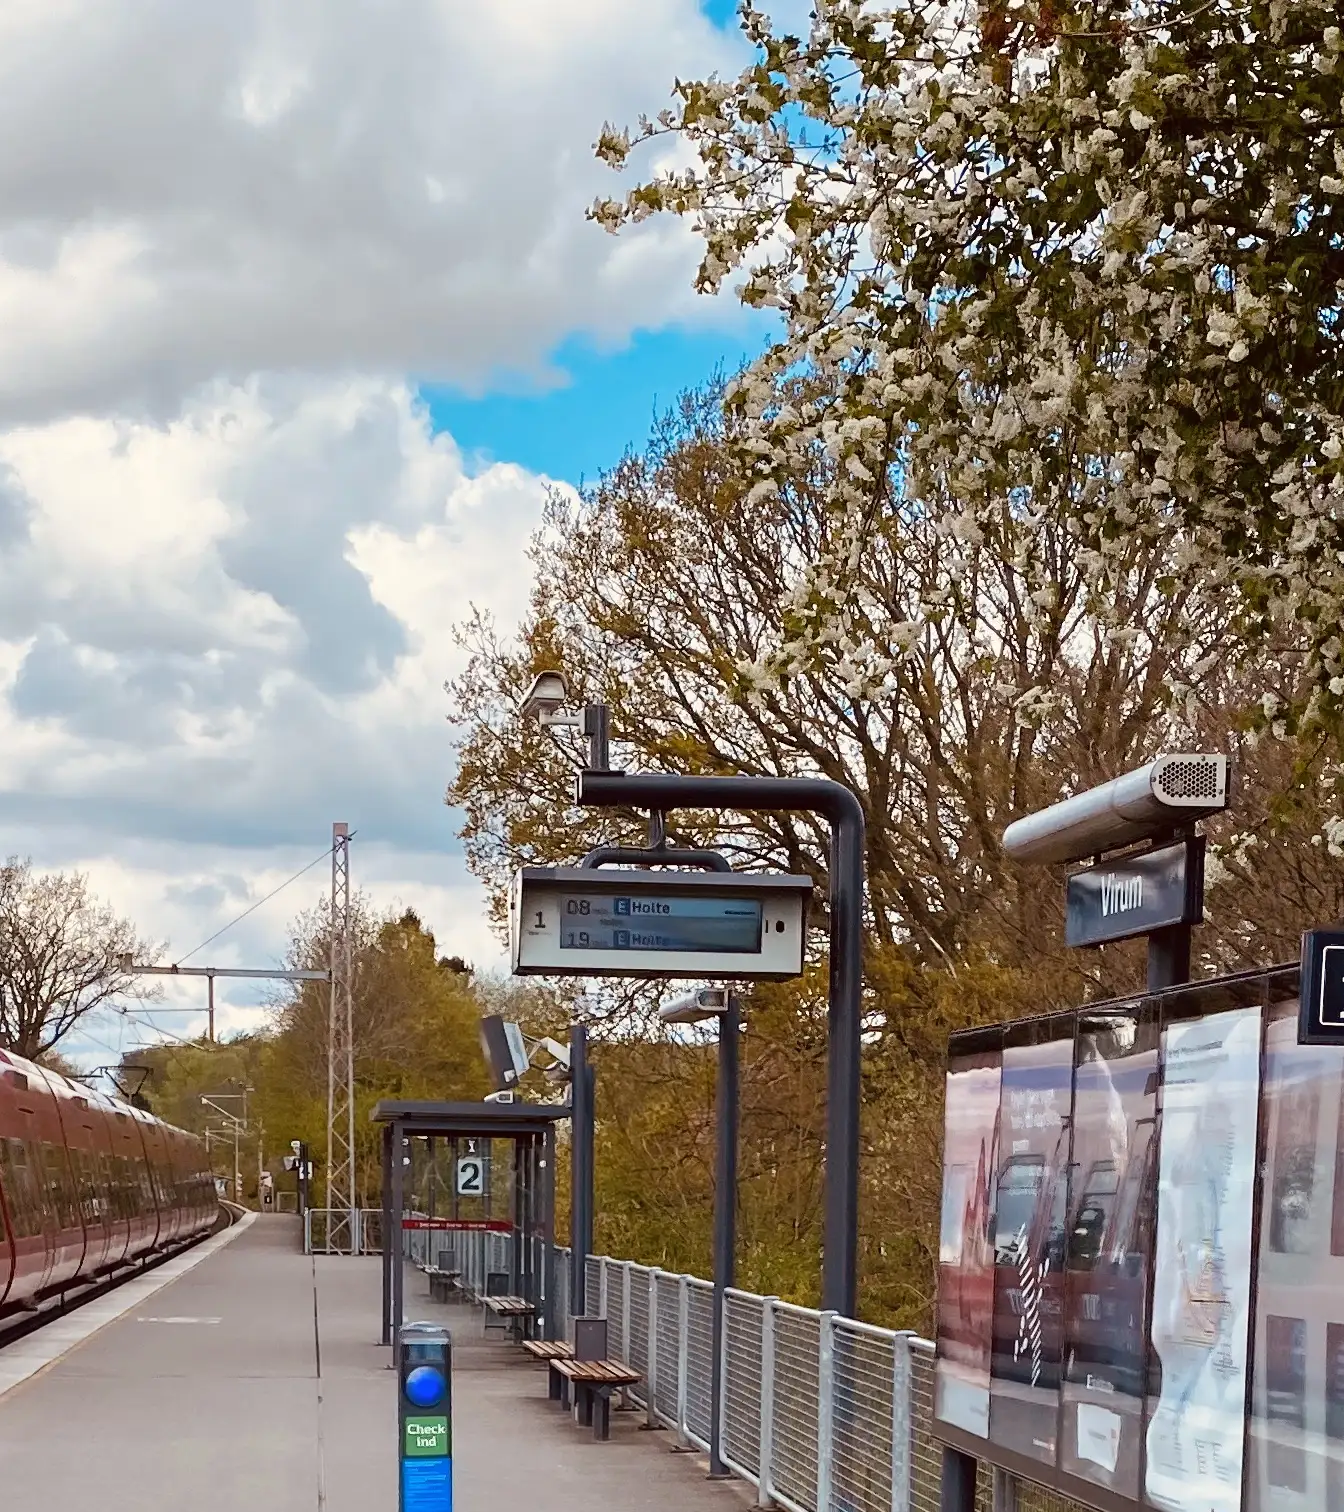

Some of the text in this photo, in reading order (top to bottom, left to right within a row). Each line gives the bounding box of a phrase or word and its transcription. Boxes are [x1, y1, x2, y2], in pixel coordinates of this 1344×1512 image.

[1101, 872, 1143, 917] Virum
[567, 899, 591, 916] 08
[631, 901, 671, 915] Holte
[534, 910, 546, 929] 1
[460, 1162, 480, 1191] 2
[407, 1423, 446, 1435] Check
